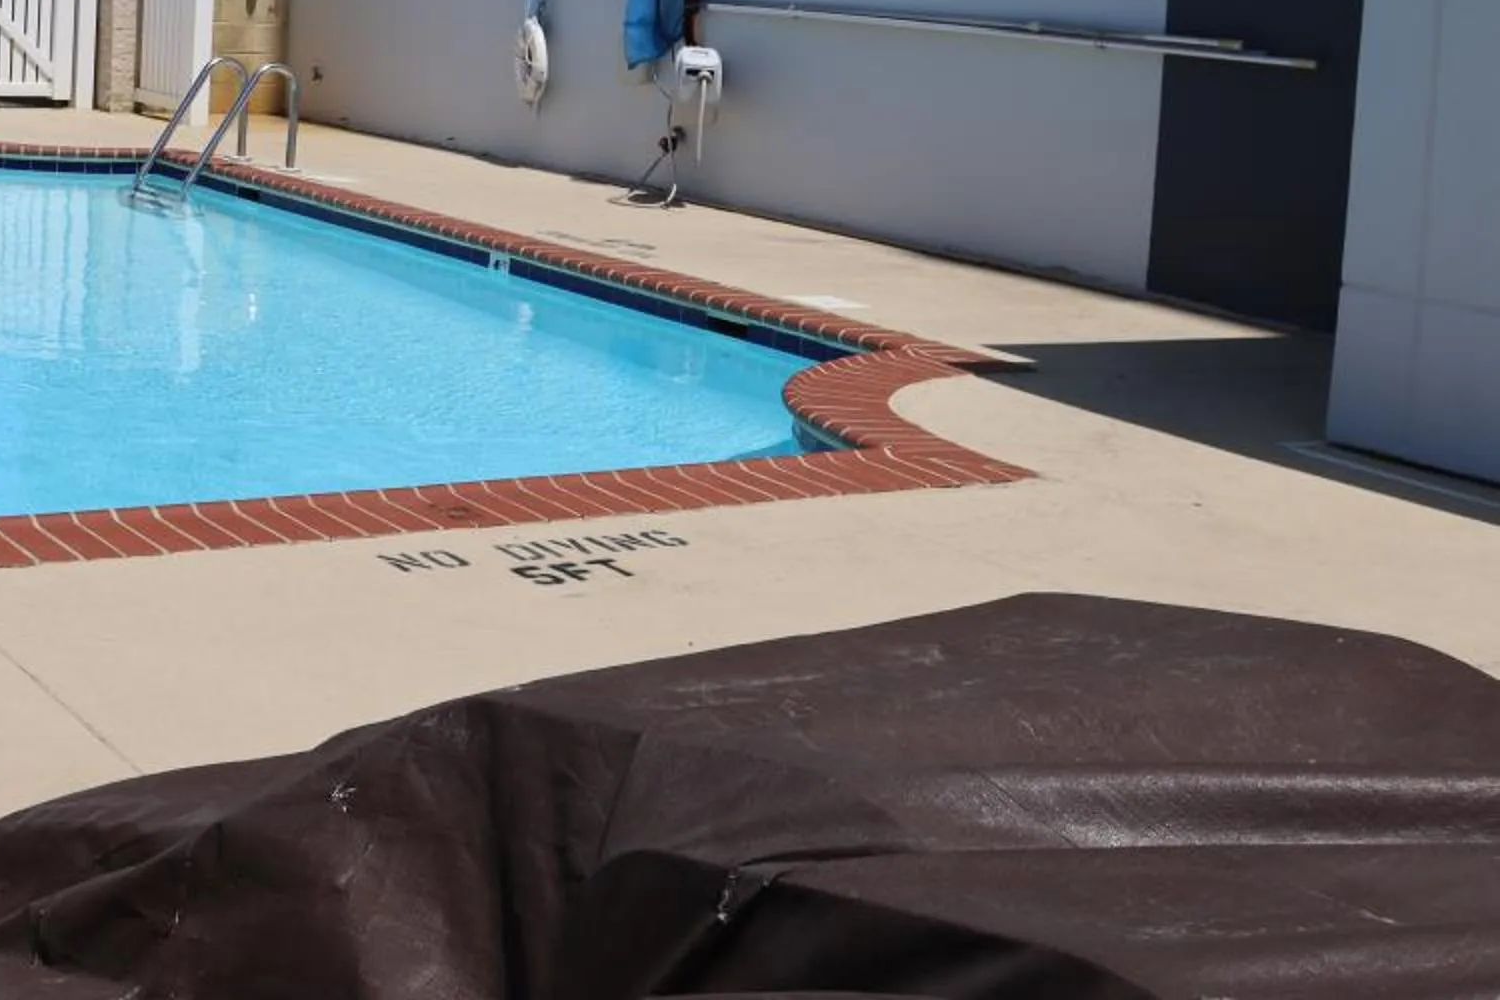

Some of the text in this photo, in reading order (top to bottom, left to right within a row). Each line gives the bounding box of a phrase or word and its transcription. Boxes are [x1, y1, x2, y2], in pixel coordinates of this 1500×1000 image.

[376, 529, 689, 573] NO DIVING
[510, 558, 635, 586] 5FT
